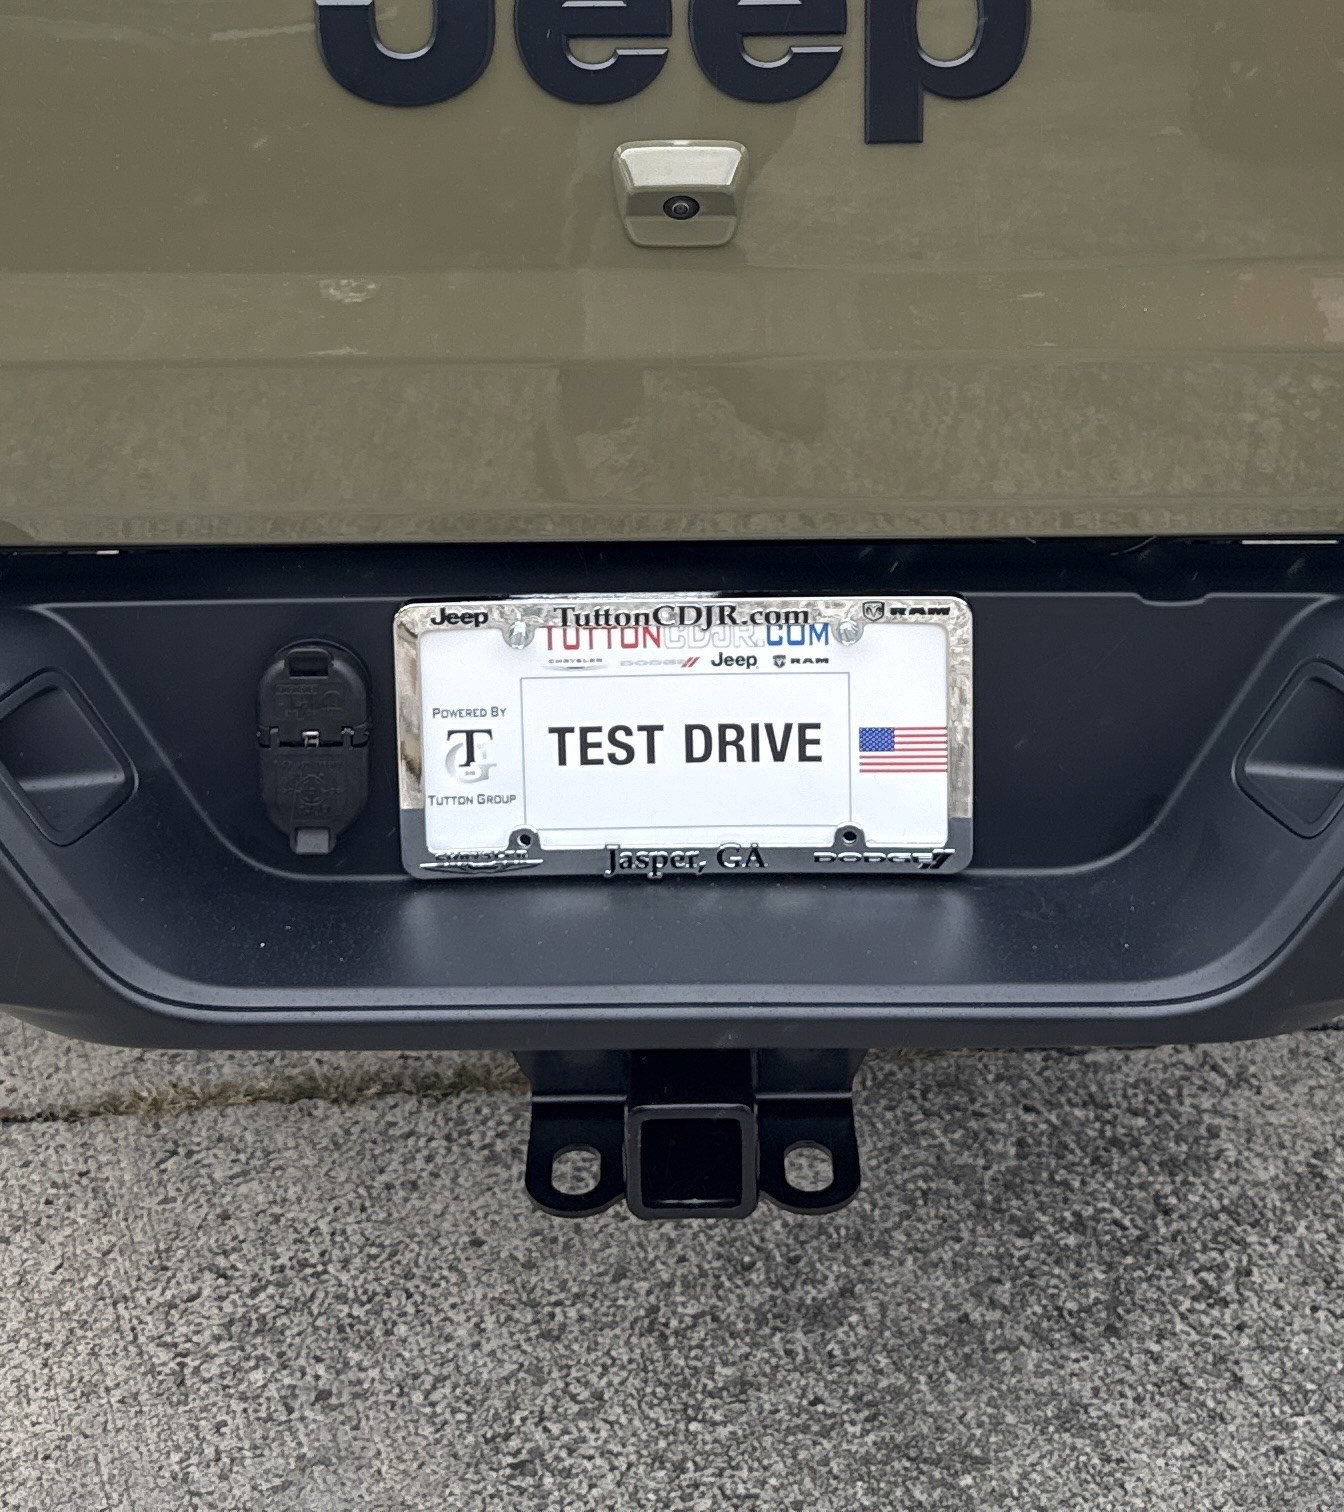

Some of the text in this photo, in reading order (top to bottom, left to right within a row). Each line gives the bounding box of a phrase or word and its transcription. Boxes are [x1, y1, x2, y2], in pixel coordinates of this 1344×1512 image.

[430, 607, 489, 628] Jeep
[554, 604, 810, 632] TuttonCDJR.com
[889, 606, 951, 617] RAM
[710, 652, 758, 669] Jeep
[790, 657, 829, 665] RAM
[432, 707, 487, 719] POWERED
[548, 722, 824, 767] TEST DRIVE
[428, 793, 517, 806] TUTTON GROUP
[604, 842, 769, 879] Jasper, GA
[813, 851, 934, 865] DODGE
